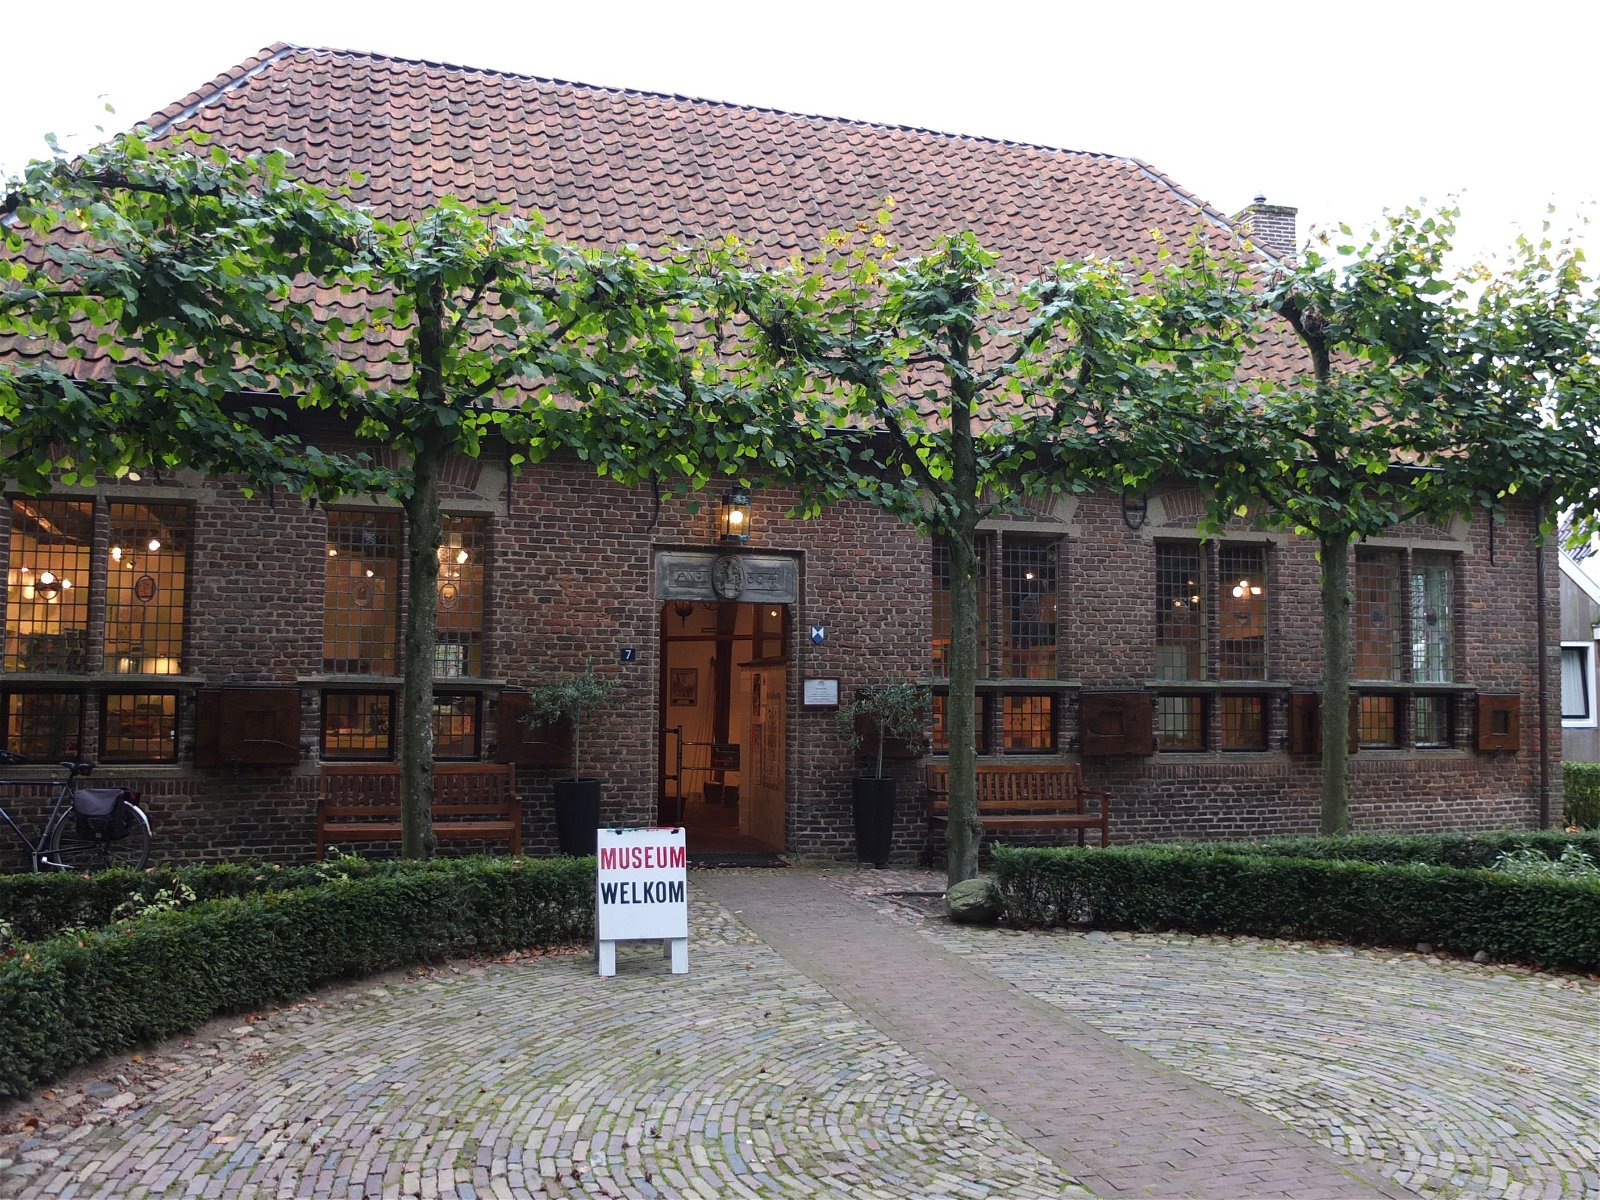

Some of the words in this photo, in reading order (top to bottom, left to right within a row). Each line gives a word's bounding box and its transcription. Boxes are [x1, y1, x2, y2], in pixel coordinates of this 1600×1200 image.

[625, 649, 632, 660] 7
[600, 846, 685, 870] MUSEUM
[600, 881, 684, 905] WELKOM
